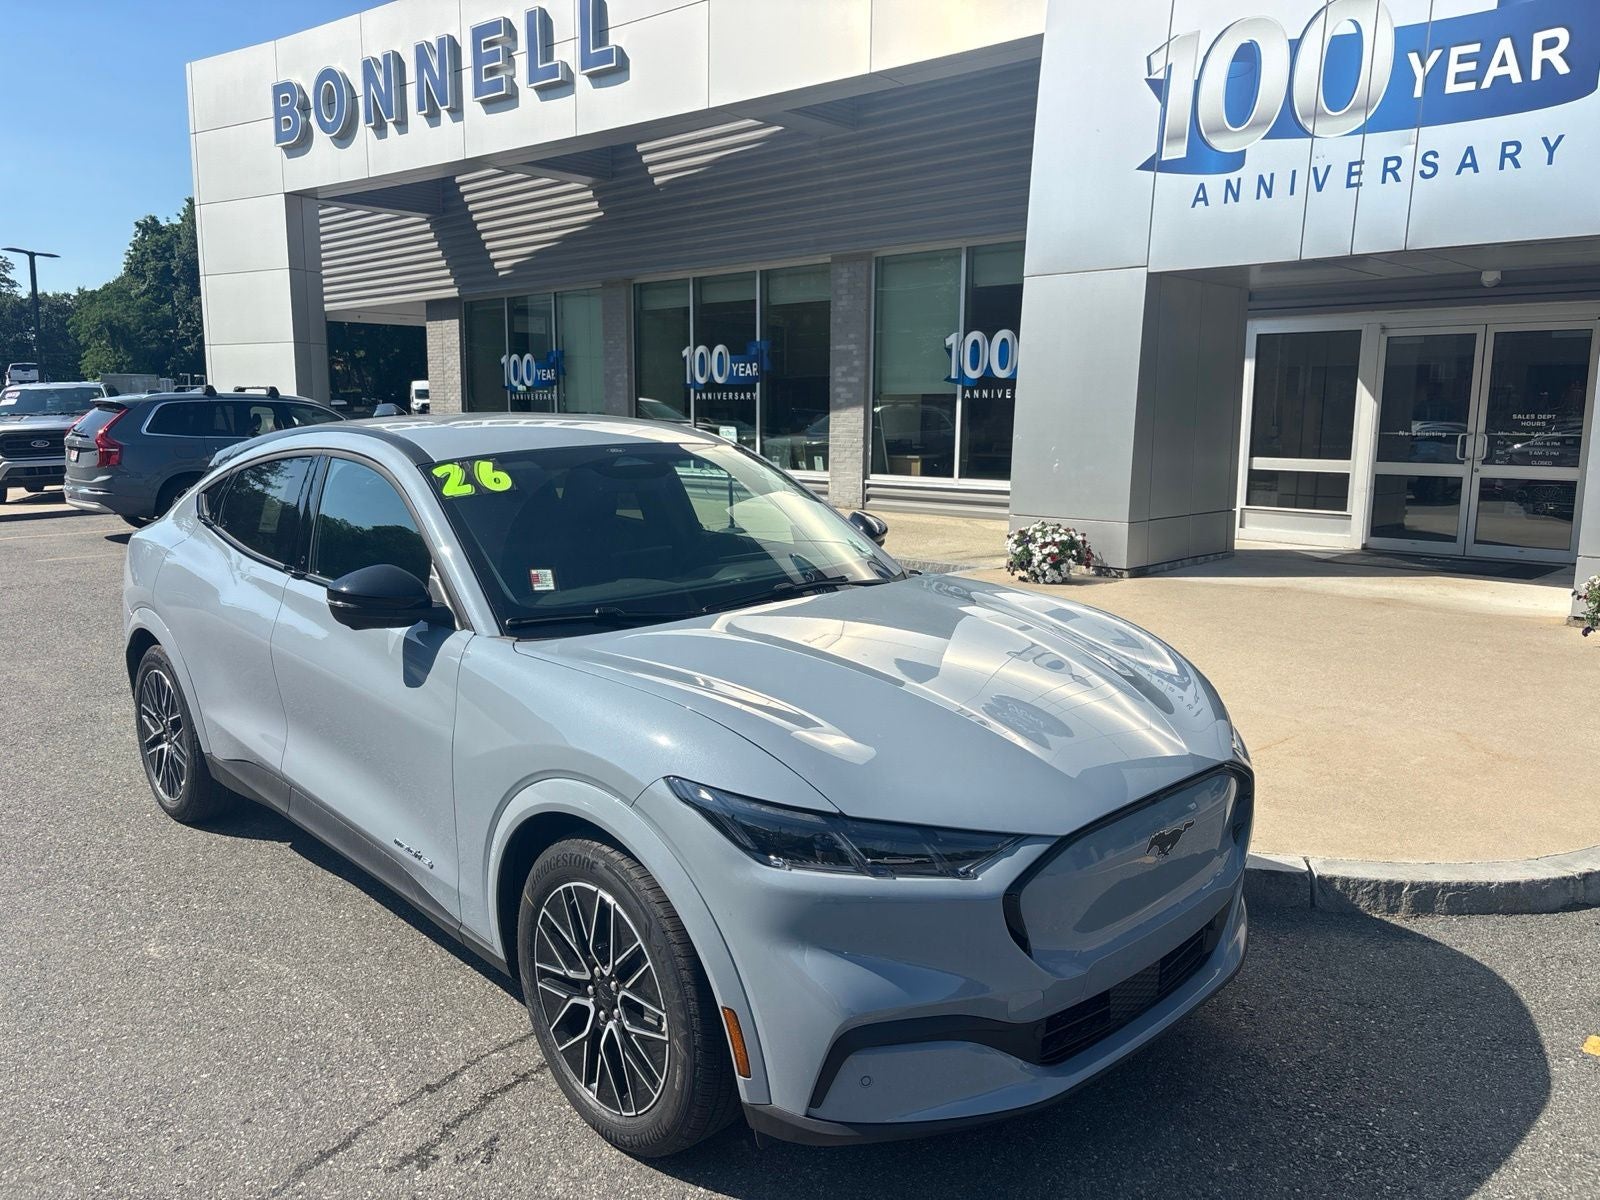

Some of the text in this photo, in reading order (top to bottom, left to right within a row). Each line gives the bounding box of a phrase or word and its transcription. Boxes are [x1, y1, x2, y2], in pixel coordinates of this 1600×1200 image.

[271, 0, 623, 147] BONNELL
[1147, 0, 1571, 160] 100 YEAR
[1191, 135, 1566, 208] ANNIVERSARY
[501, 353, 555, 387] 100 YEAR
[682, 344, 758, 384] 100 YEAR
[945, 329, 1018, 379] 100
[696, 392, 757, 400] ANNIVERSARY
[963, 388, 1017, 399] ANNIVE
[432, 460, 512, 497] 26
